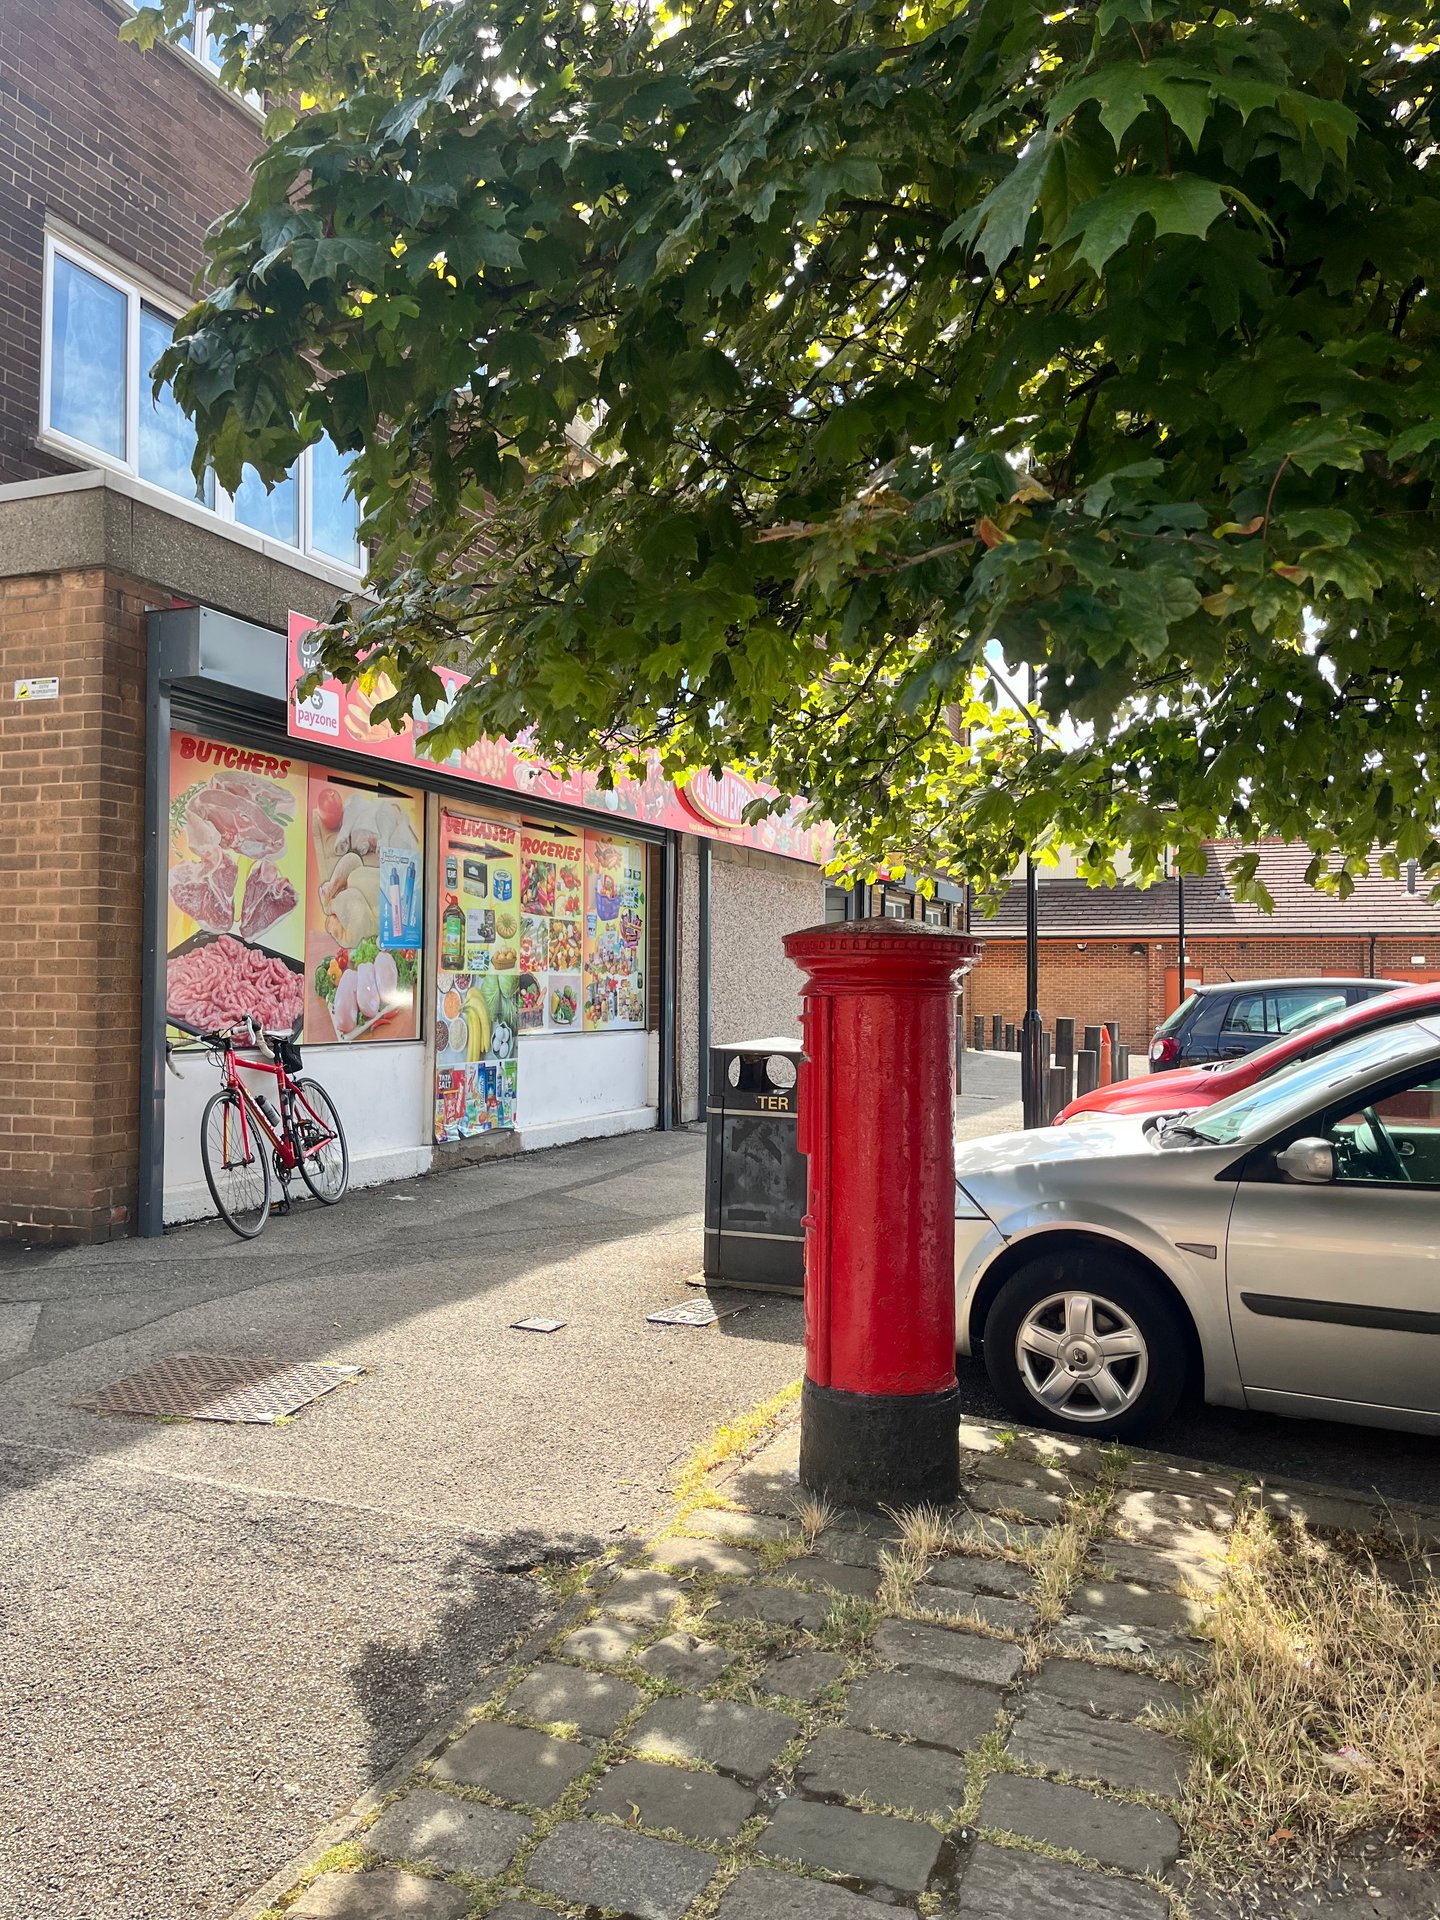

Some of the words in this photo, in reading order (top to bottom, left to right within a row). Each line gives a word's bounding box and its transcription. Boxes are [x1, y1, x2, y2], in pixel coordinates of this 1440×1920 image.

[298, 709, 337, 728] payzone
[180, 737, 292, 779] BUTCHERS
[521, 837, 582, 861] ROCERIES
[757, 1095, 789, 1110] TER
